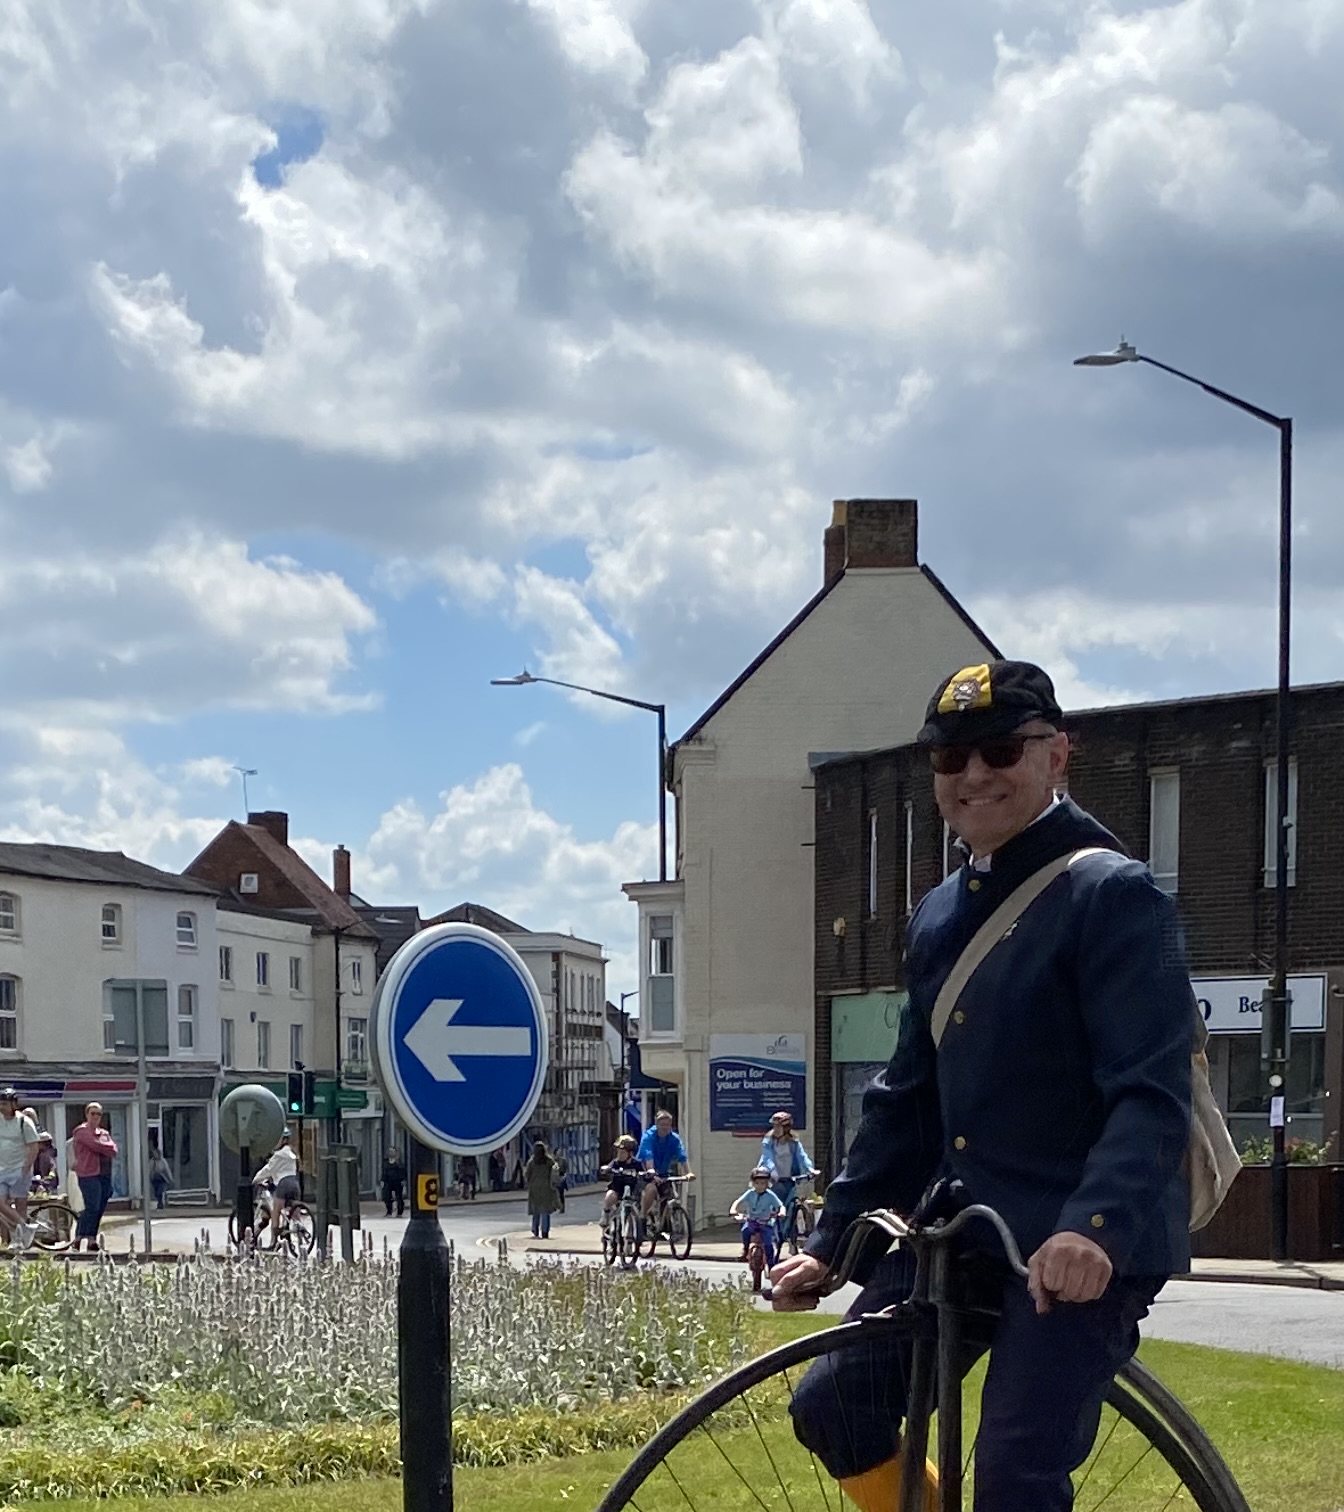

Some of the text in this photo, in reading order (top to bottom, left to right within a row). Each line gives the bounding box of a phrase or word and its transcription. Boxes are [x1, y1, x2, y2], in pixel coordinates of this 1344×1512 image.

[717, 1068, 765, 1080] Open for
[716, 1080, 792, 1092] your business
